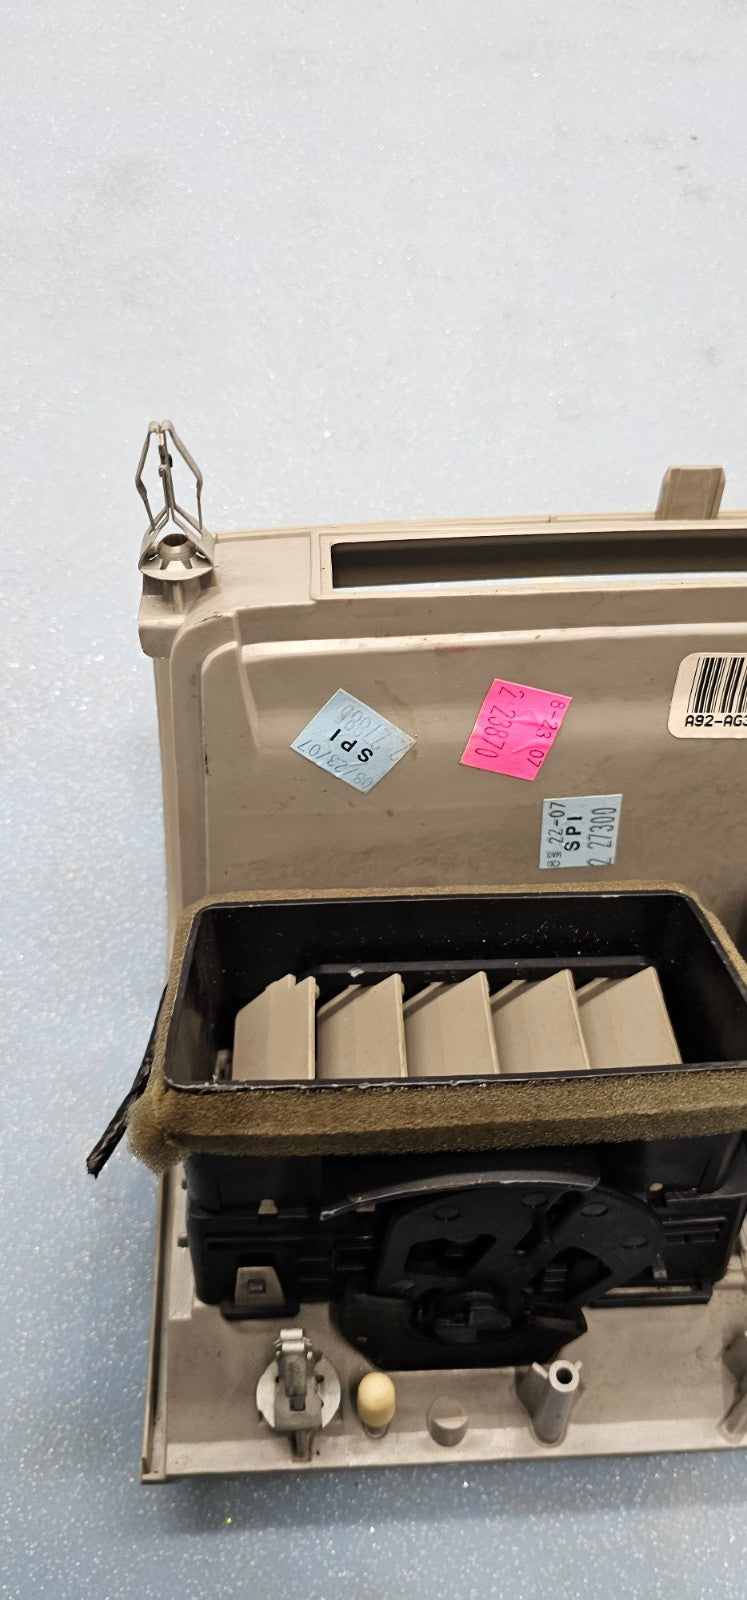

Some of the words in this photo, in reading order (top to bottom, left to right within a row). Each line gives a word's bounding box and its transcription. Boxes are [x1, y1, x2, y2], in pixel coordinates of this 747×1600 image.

[499, 686, 525, 699] 2
[329, 728, 374, 763] SPI
[475, 705, 516, 758] 23870
[297, 739, 374, 788] 08/23/07
[563, 816, 583, 851] SPI
[587, 807, 617, 850] 27300
[587, 857, 612, 867] 2
